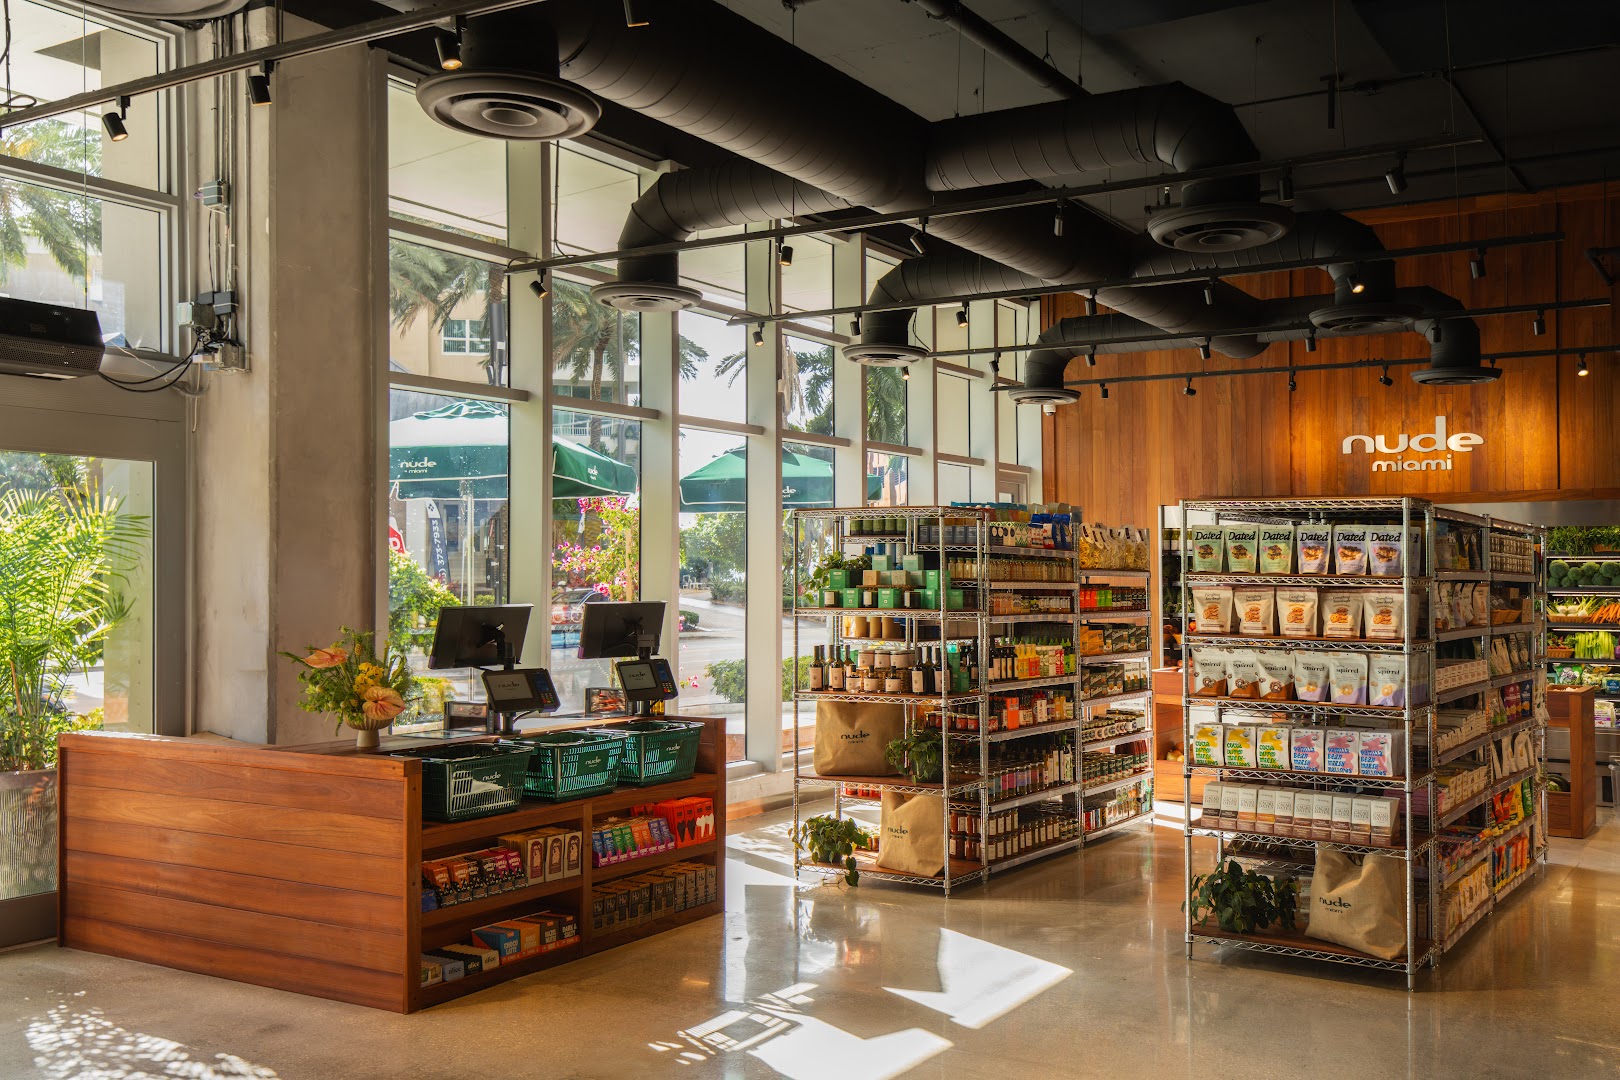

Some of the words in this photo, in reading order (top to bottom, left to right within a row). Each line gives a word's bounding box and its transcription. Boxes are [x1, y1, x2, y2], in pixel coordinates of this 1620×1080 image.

[1342, 415, 1484, 454] nude
[400, 457, 437, 468] nude
[1372, 454, 1452, 472] miami
[782, 486, 796, 494] de
[1195, 531, 1222, 540] Dated
[1228, 531, 1256, 540] Dated
[1262, 531, 1291, 540] Dated
[1300, 532, 1329, 541] Dated
[1337, 532, 1366, 541] Dated
[1370, 532, 1402, 542] Dated
[432, 520, 445, 566] 373-7933
[841, 730, 870, 740] nude
[888, 825, 908, 835] nude
[1319, 897, 1352, 908] nude
